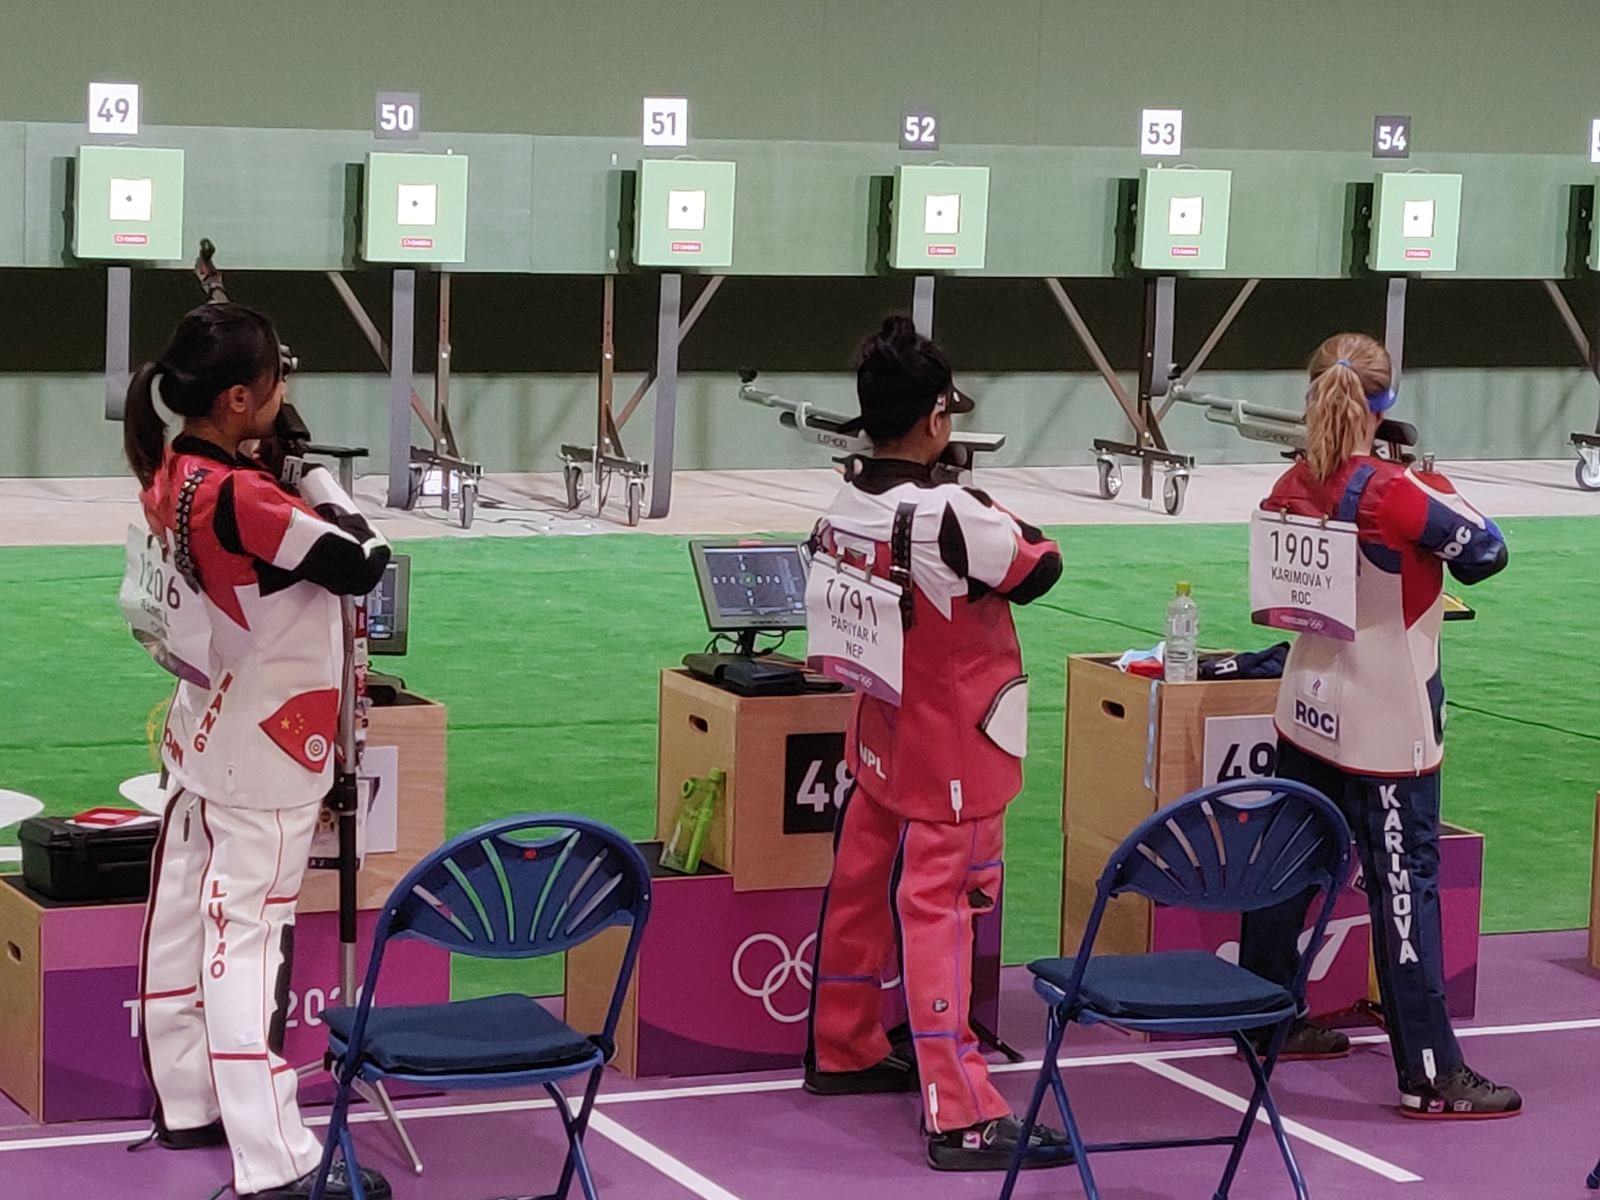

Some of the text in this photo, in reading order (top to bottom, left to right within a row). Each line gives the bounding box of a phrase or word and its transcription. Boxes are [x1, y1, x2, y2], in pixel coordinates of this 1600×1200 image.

[97, 97, 130, 123] 49
[380, 104, 415, 131] 50
[651, 111, 677, 136] 51
[904, 116, 936, 143] 52
[1147, 122, 1176, 146] 53
[1377, 125, 1407, 151] 54
[1270, 530, 1330, 570] 1905
[1271, 566, 1333, 590] KARIMOVA Y
[826, 578, 878, 627] 1791
[1291, 589, 1312, 606] ROC
[831, 614, 879, 646] PARIYAR K
[845, 640, 864, 660] NEP
[1295, 698, 1335, 735] ROC
[1217, 742, 1276, 783] 49
[796, 759, 856, 813] 48
[1379, 784, 1419, 965] KARIMOVA
[208, 880, 230, 980] LUYAO
[286, 986, 377, 1028] 20
